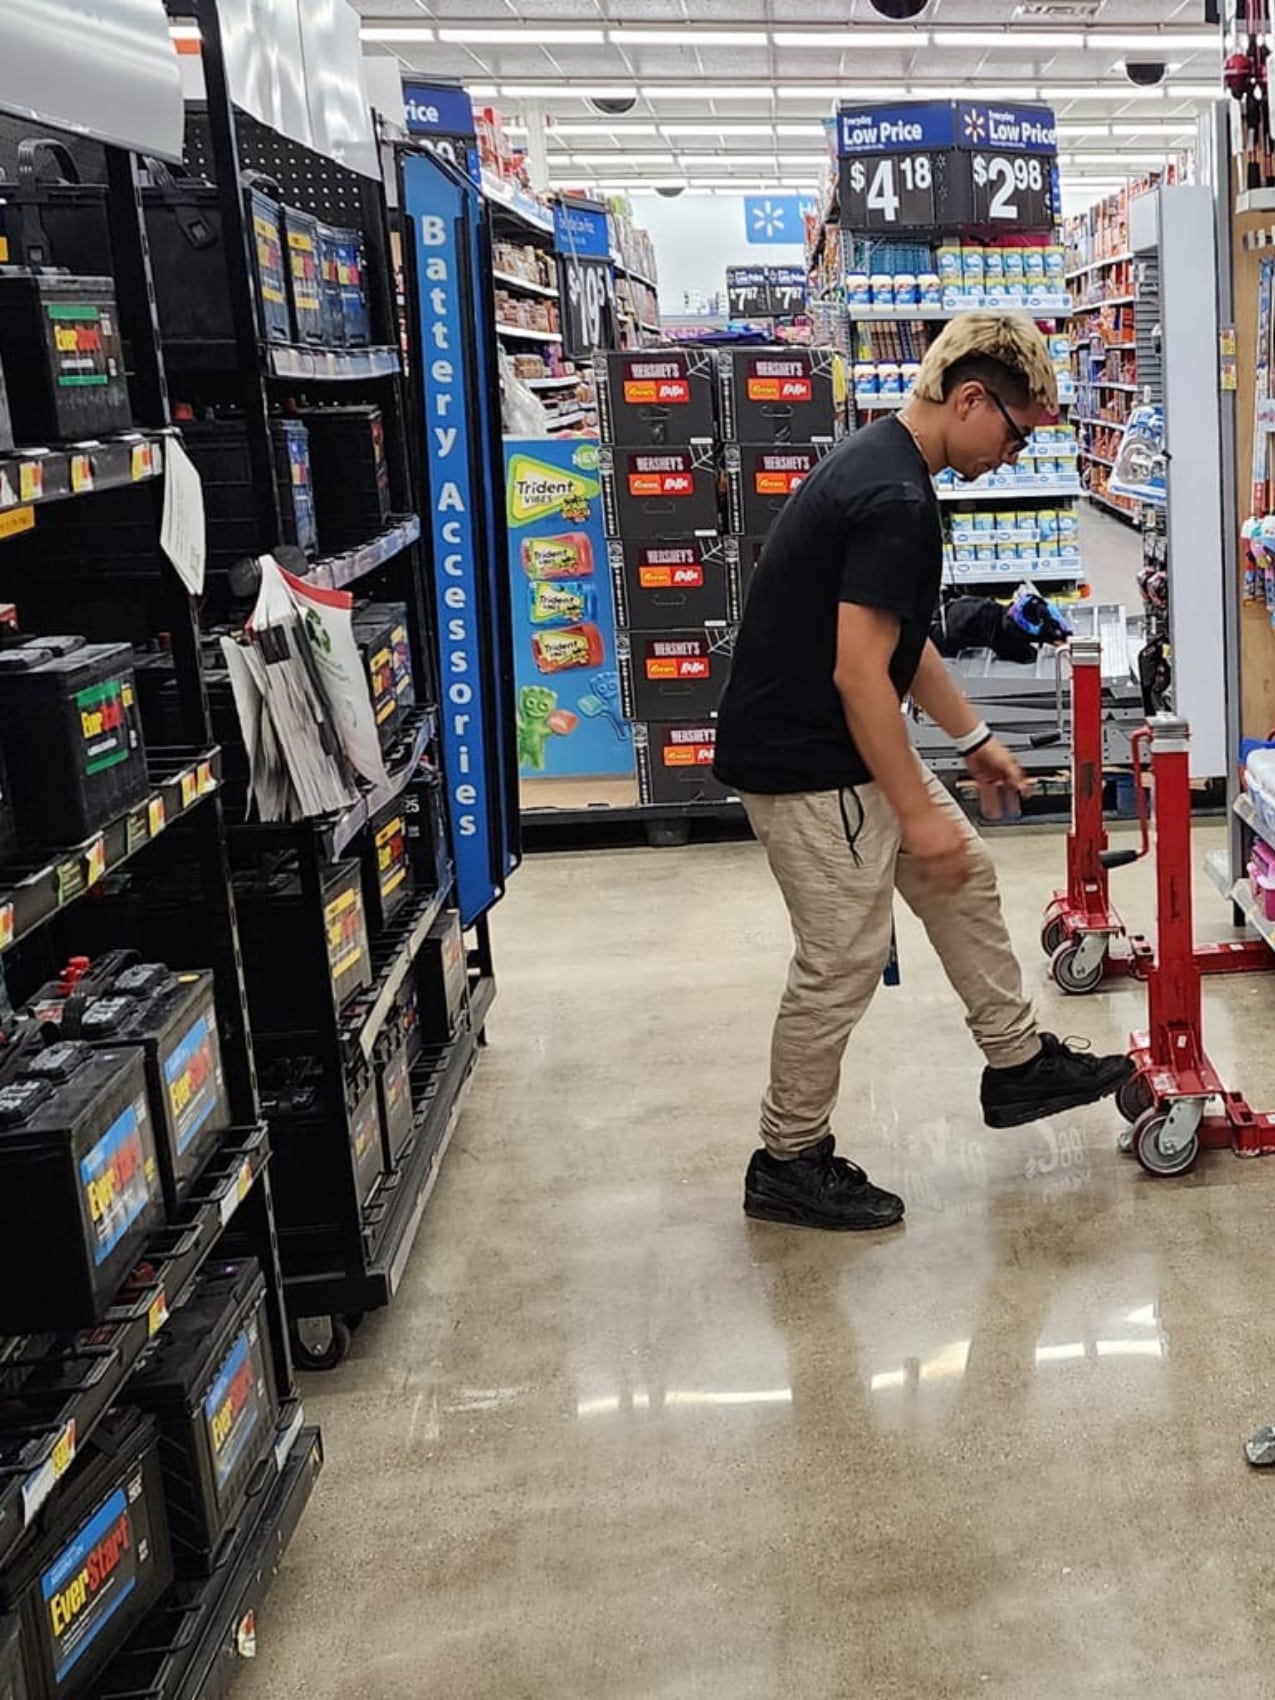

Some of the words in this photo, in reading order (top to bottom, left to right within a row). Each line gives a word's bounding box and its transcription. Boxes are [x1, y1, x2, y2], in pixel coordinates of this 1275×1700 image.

[404, 100, 439, 122] rice
[843, 125, 877, 145] Low
[880, 121, 923, 142] Price
[989, 120, 1023, 140] Low
[1022, 122, 1056, 145] Price
[421, 214, 458, 458] Battery
[516, 480, 574, 496] Trident
[437, 482, 478, 836] Accessories
[50, 1512, 131, 1639] EverStart
